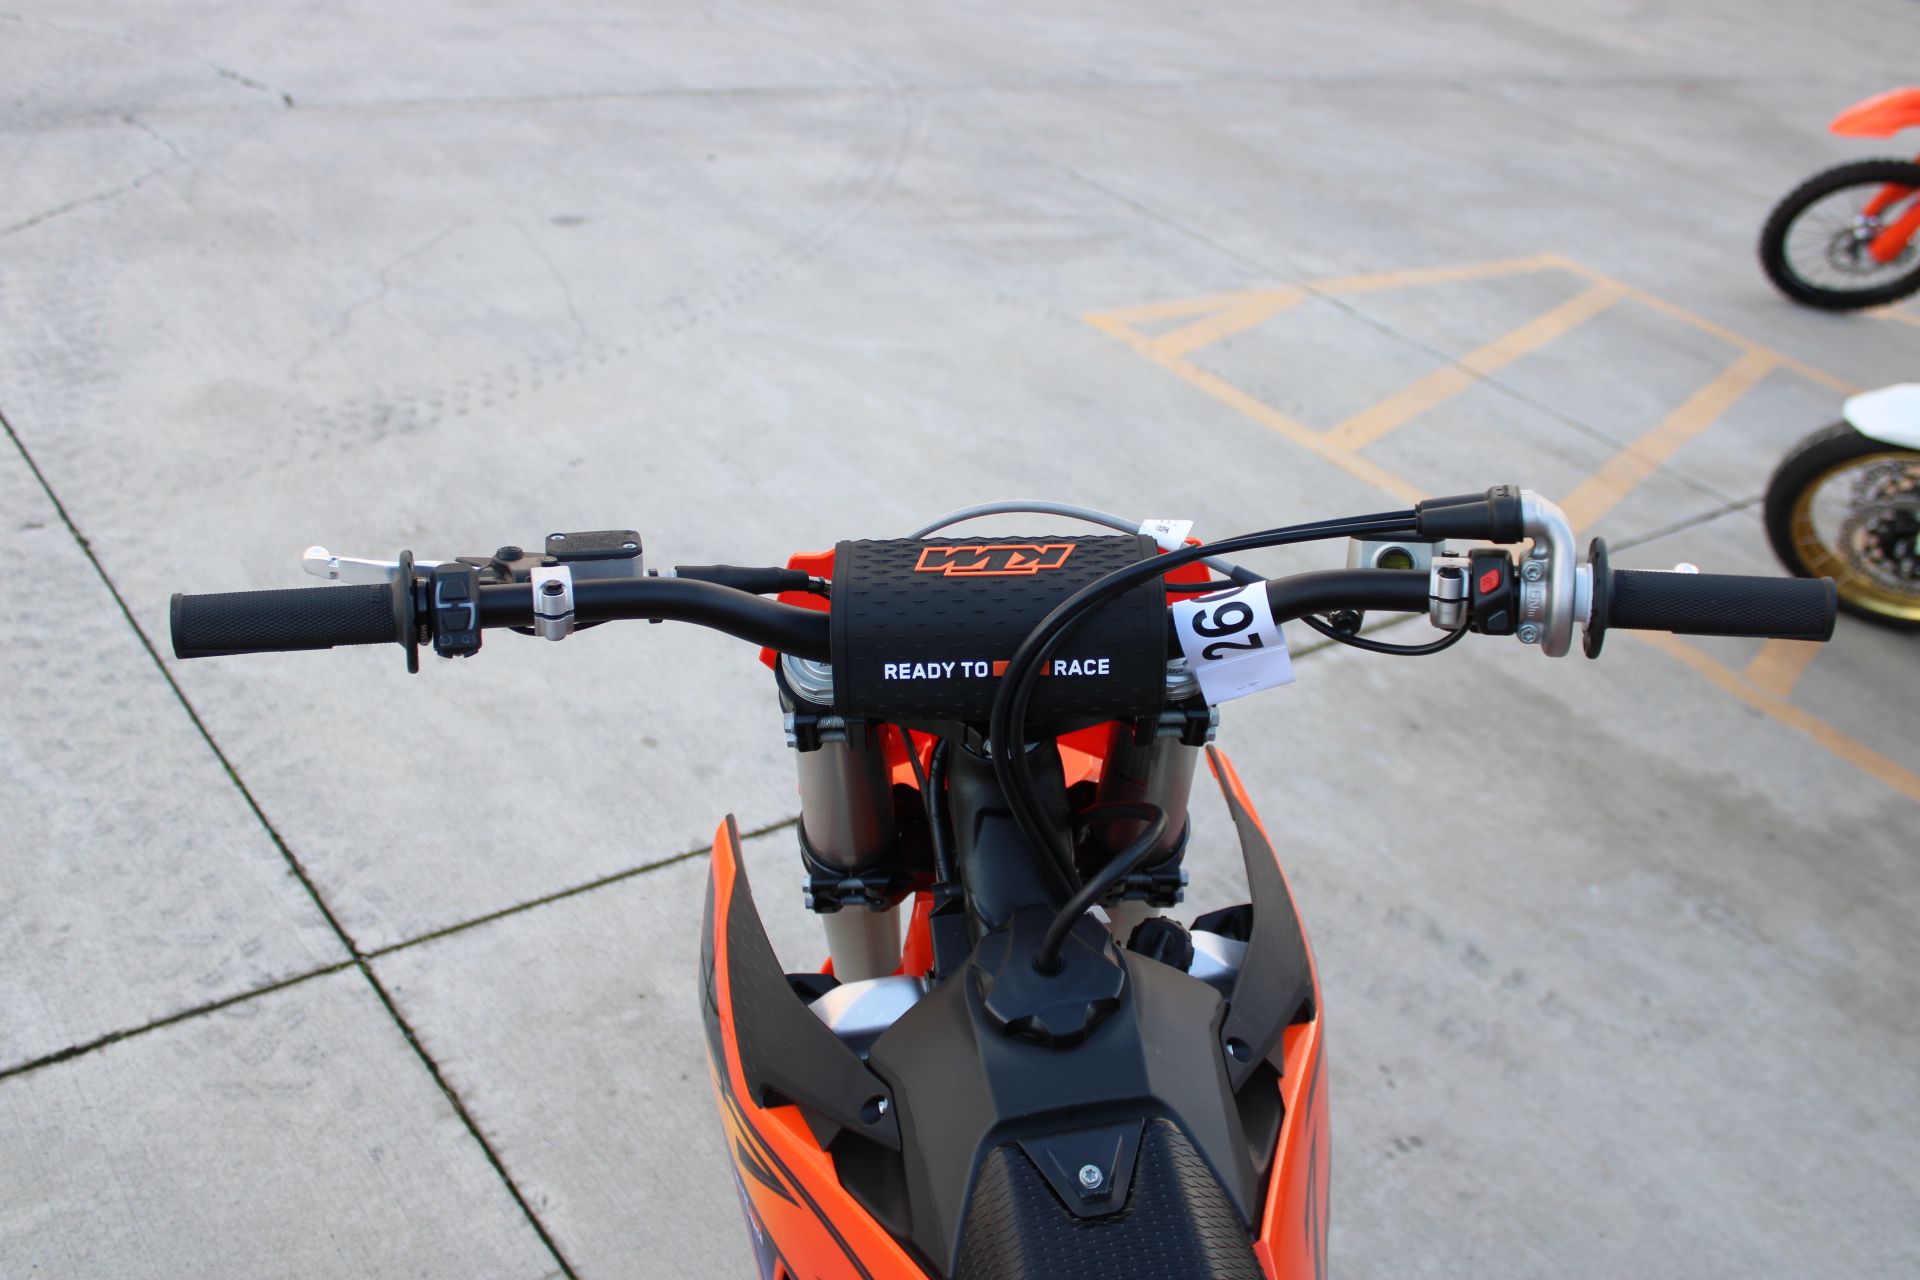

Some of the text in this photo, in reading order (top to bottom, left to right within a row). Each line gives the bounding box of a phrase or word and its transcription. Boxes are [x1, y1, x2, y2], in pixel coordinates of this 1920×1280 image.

[914, 544, 1077, 576] KTM
[1190, 585, 1264, 661] 26
[884, 658, 1110, 680] READY TO RACE
